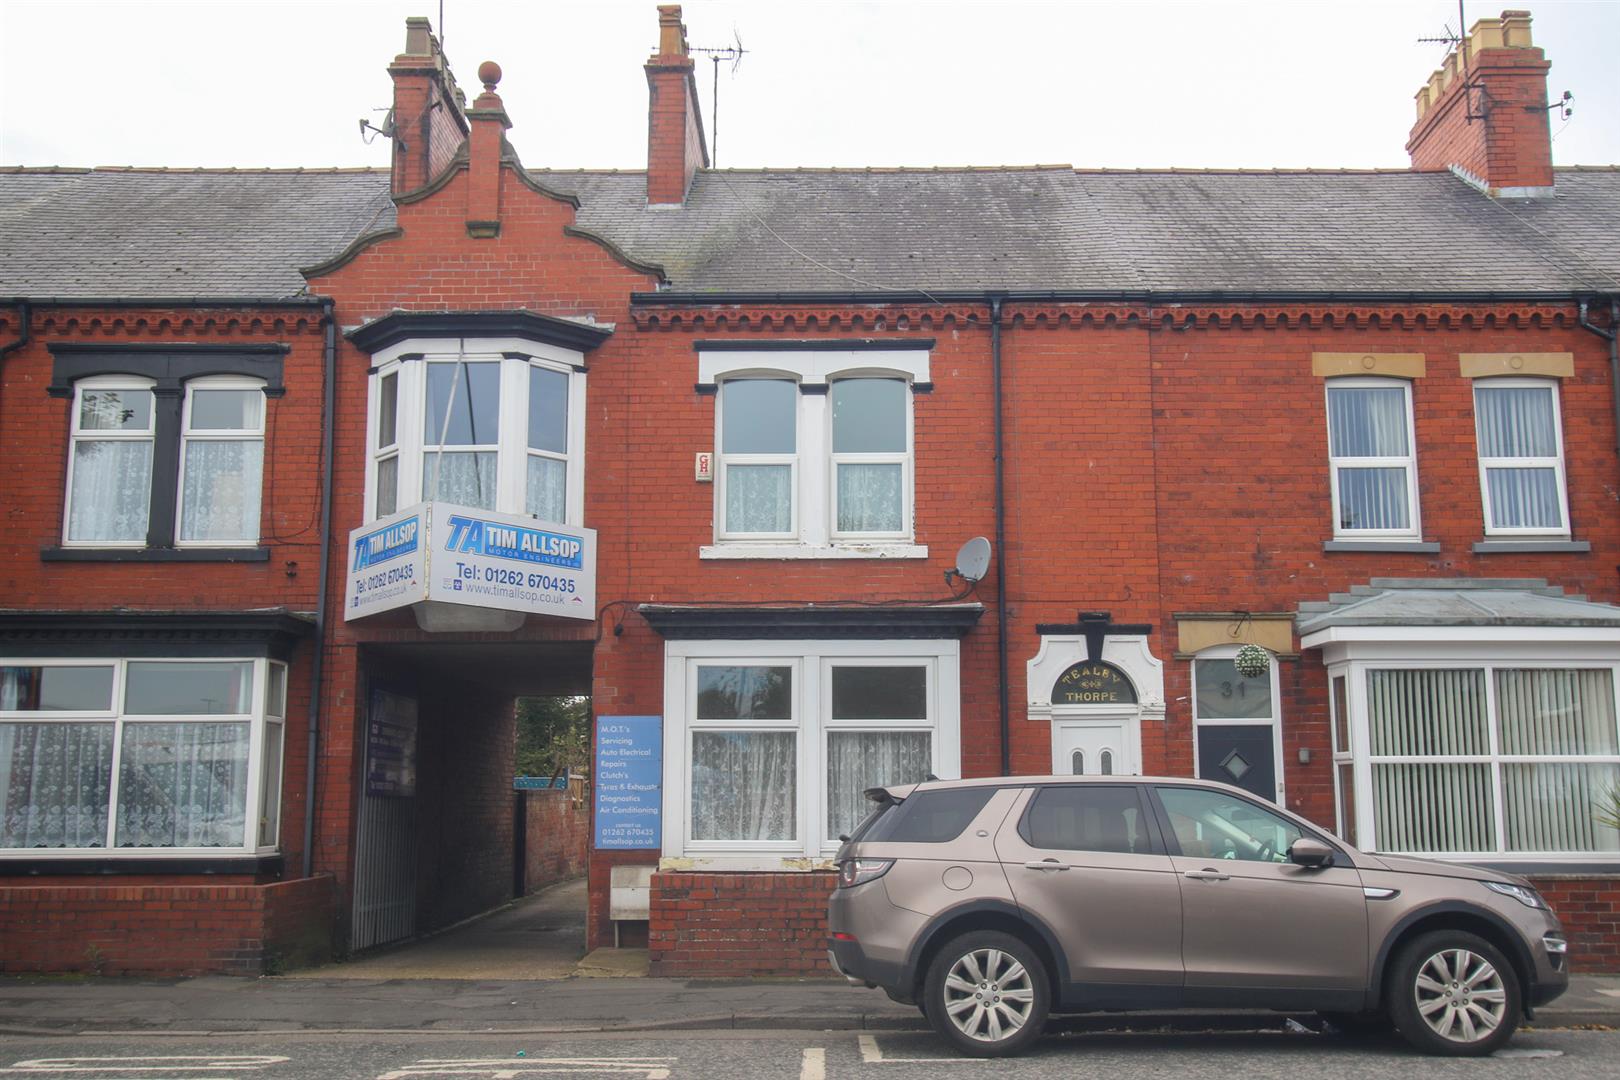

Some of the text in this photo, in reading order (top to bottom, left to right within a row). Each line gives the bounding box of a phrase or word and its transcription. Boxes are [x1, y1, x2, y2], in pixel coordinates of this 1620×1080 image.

[369, 521, 417, 555] TIM ALLSOP
[446, 515, 483, 554] TA
[487, 526, 580, 558] TIM ALLSOP
[352, 536, 369, 573] TA
[488, 548, 519, 557] MOTOR
[524, 552, 571, 565] ENGINEERS
[356, 563, 413, 594] Tel: 01262 670435
[456, 562, 575, 593] Tel: 01262 670435
[466, 582, 565, 605] www.timallsop.co.uk
[1062, 666, 1120, 684] TEALBY
[1065, 692, 1118, 701] THORPE
[1221, 680, 1245, 697] 31
[601, 737, 633, 745] Servicing
[620, 748, 651, 756] Electrical
[601, 761, 626, 769] Repairs
[600, 795, 640, 803] Diagnostics
[612, 806, 658, 815] Conditioning
[602, 838, 654, 846] timallsop.co.uk
